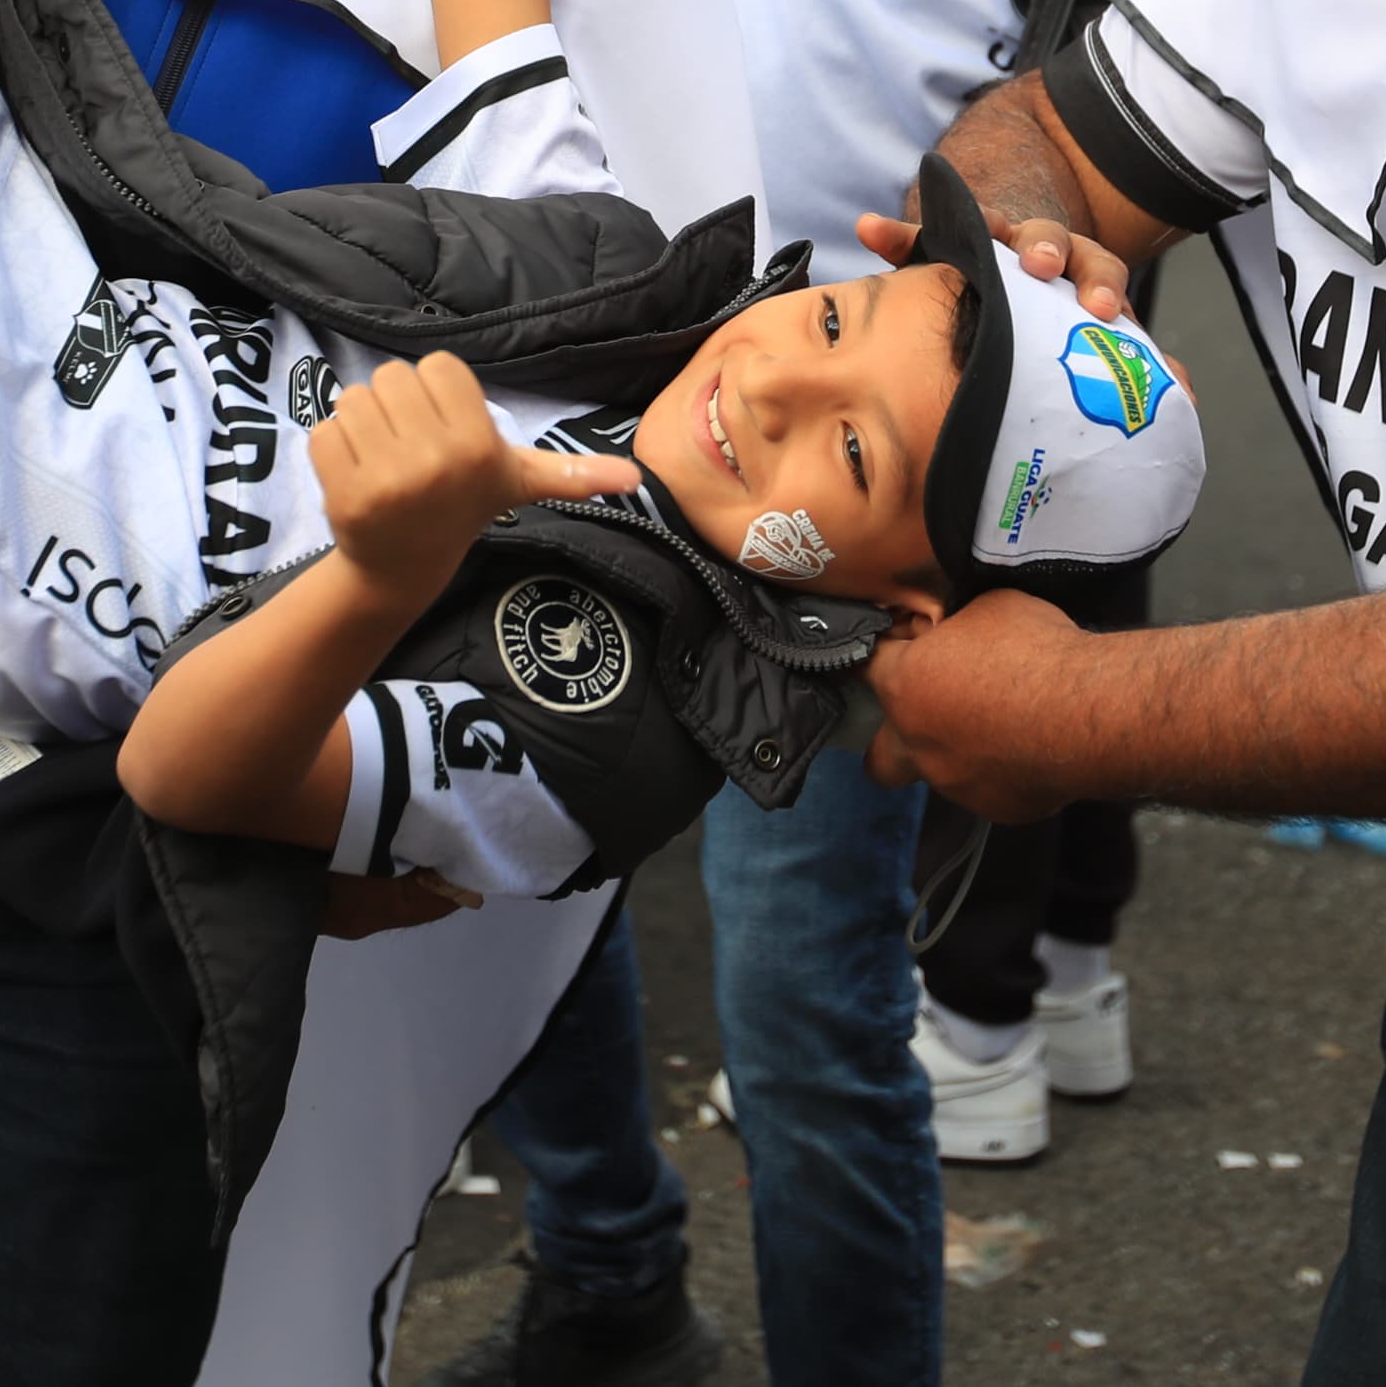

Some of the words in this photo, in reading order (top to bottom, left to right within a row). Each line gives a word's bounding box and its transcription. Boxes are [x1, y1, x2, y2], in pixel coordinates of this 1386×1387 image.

[298, 368, 312, 428] GAS
[1084, 329, 1142, 423] COMUNICACIONES
[1025, 448, 1046, 487] LIGA
[792, 508, 825, 551] CREMA
[1007, 490, 1032, 544] GUATE
[20, 534, 166, 674] epsi
[506, 584, 541, 620] and
[503, 622, 539, 685] fitch
[566, 589, 622, 703] abercrombie
